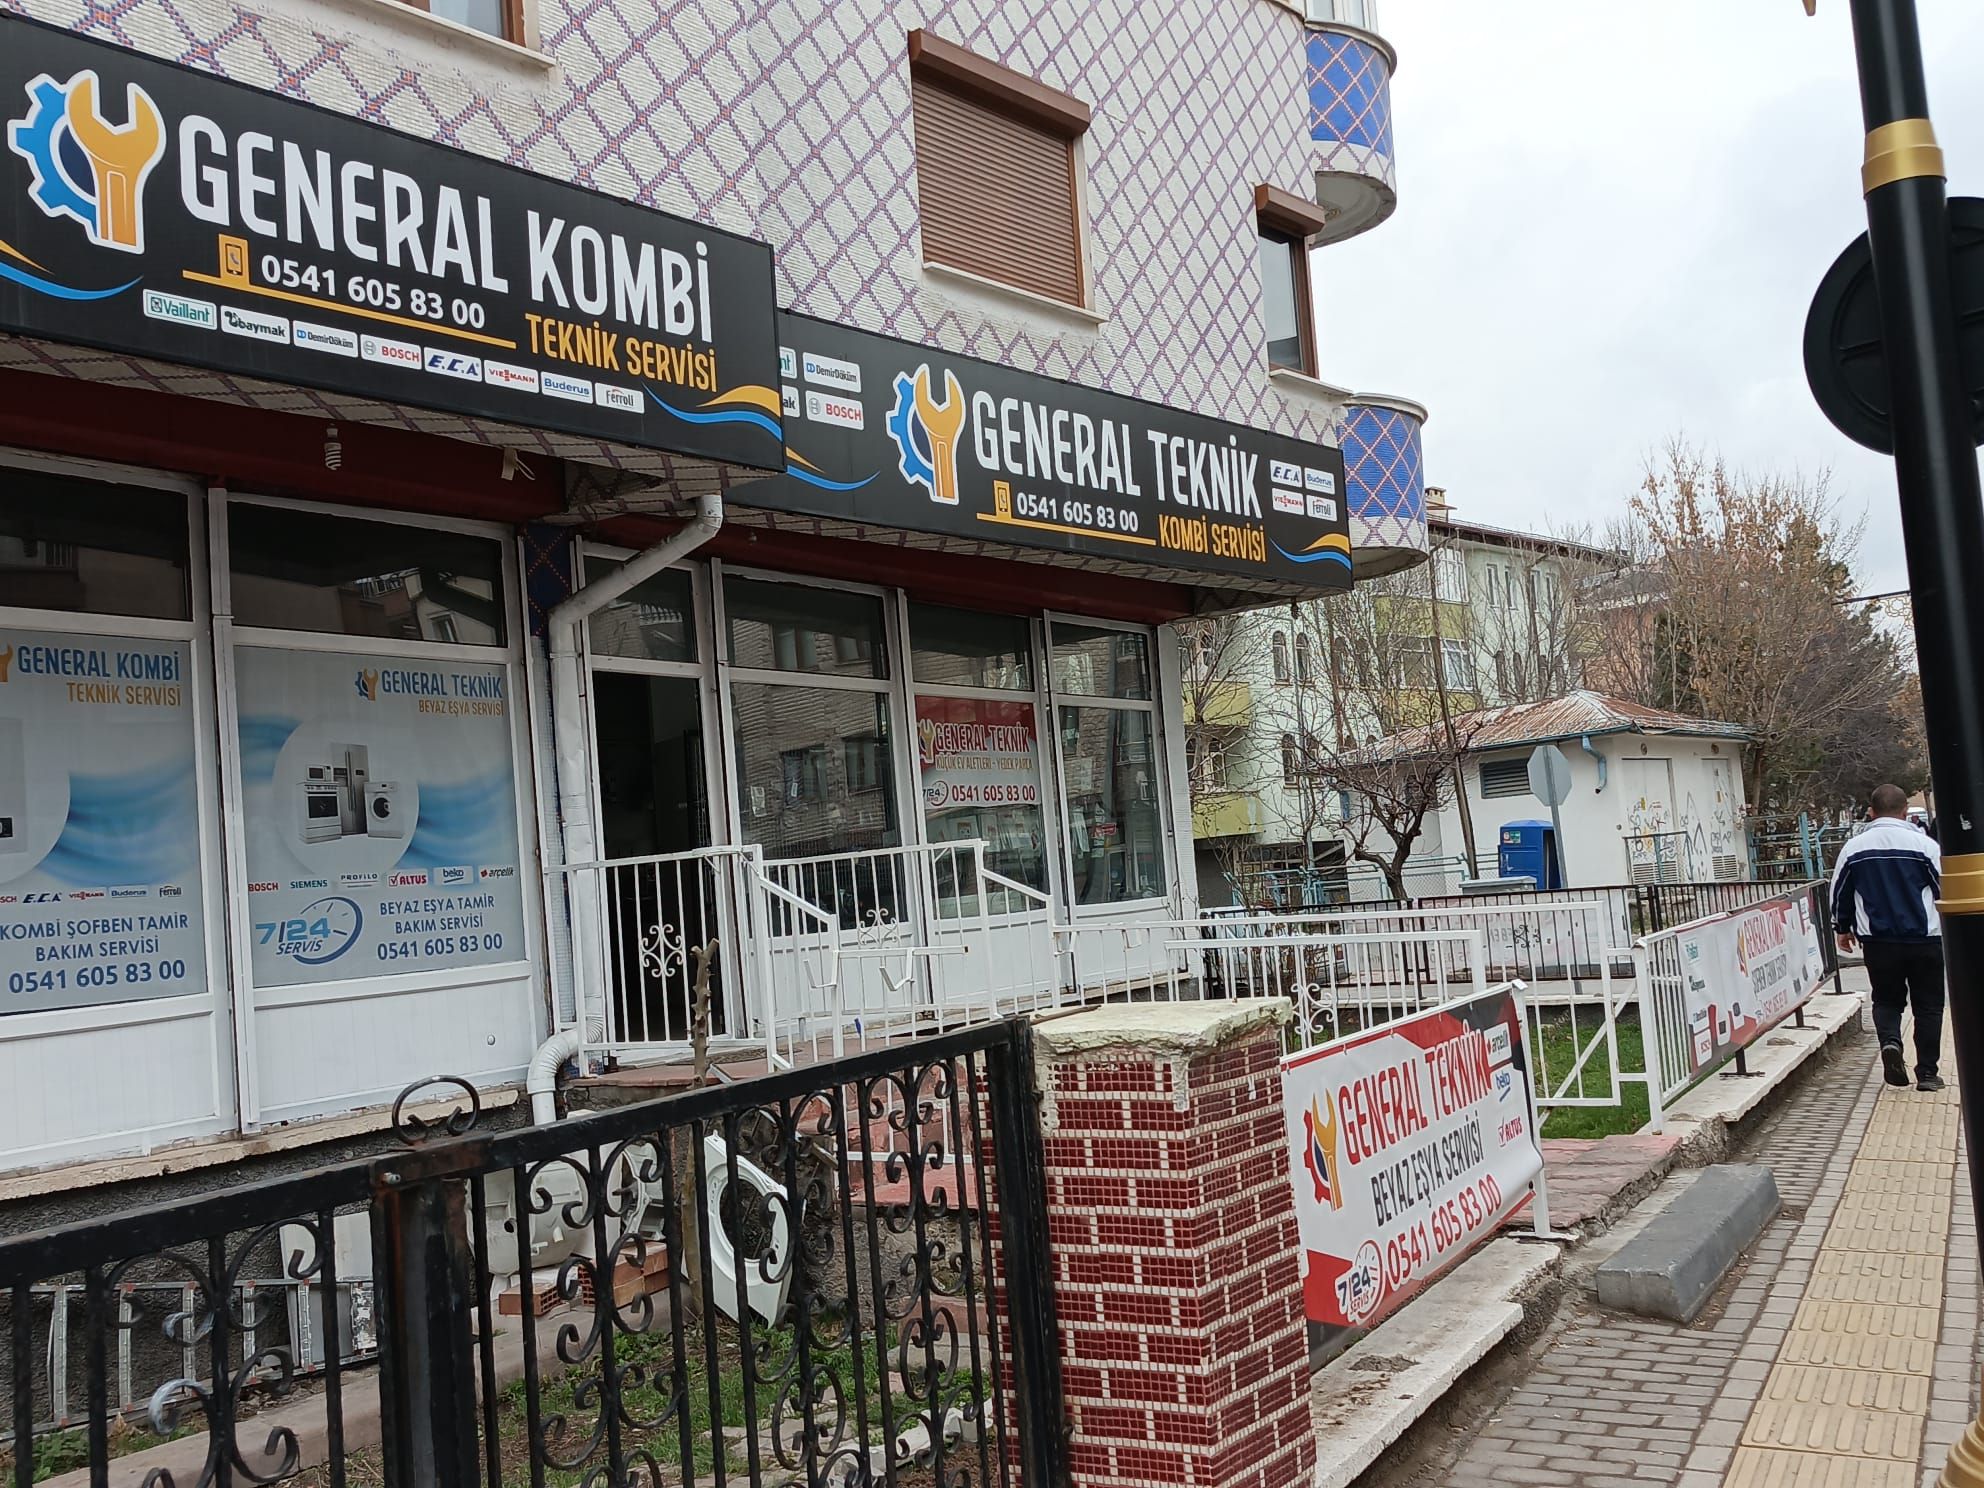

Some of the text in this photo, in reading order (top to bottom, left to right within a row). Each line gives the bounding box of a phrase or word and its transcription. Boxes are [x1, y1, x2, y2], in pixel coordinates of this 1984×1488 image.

[179, 114, 713, 342] GENERAL KOMBİ
[261, 253, 485, 329] 0541 605 83 00
[163, 296, 211, 323] Vaillant
[238, 317, 286, 339] baymak
[307, 331, 355, 350] DemirDöküm
[382, 346, 420, 363] BOSCH
[544, 377, 590, 396] Buderus
[605, 389, 634, 408] Ferroli
[525, 313, 718, 393] TEKNİK SERVİSİ
[815, 365, 857, 383] DemirDöküm
[826, 403, 862, 421] BOSCH
[972, 391, 1262, 519] GENERAL TEKNİK
[1017, 492, 1138, 532] 0541 605 83 00
[1159, 514, 1267, 562] KOMBİ SERVİSİ
[17, 645, 180, 681] GENERAL KOMBİ
[66, 681, 181, 706] TEKNİK SERVİSİ
[381, 670, 503, 699] GENERAL TEKNİK
[419, 700, 447, 714] BEYAZ
[449, 700, 469, 717] EŞYA
[935, 721, 1030, 752] GENERAL TEKNİK
[952, 784, 1036, 801] 0541 605 83 00
[248, 882, 279, 892] BOSCH
[290, 879, 328, 889] SIEMENS
[400, 875, 427, 886] ALTUS
[443, 868, 465, 879] beko
[488, 867, 514, 878] arçelik
[0, 895, 17, 904] SCH
[159, 885, 182, 898] Ferroli
[380, 893, 495, 916] BEYAZ EŞYA TAMİR
[0, 912, 188, 940] KOMBİ ŞOFBEN TAMİR
[395, 912, 484, 934] BAKIM SERVİSİ
[36, 935, 159, 962] BAKIM SERVİSİ
[276, 937, 324, 956] SERVİS
[377, 933, 503, 961] 0541 605 83 00
[9, 960, 186, 994] 0541 605 83 00
[1338, 1020, 1492, 1165] GENERAL TEKNİK
[1505, 1116, 1522, 1141] ALTUS
[1370, 1111, 1483, 1227] BEYAZ EŞYA SERVİSİ
[1387, 1174, 1502, 1287] 0541 605 83 00
